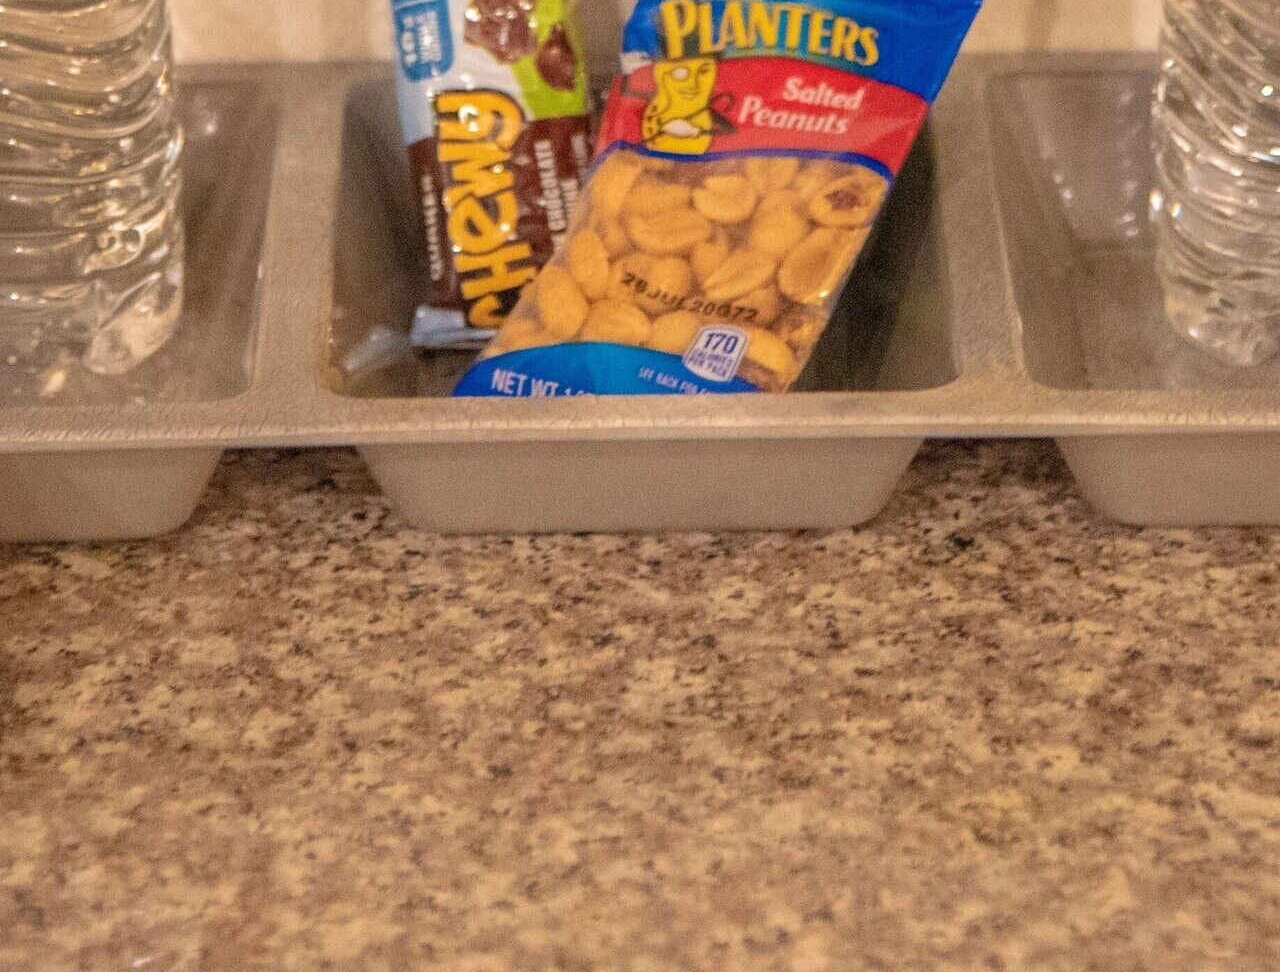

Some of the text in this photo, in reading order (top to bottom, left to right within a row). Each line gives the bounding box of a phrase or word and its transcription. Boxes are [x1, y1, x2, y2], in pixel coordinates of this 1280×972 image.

[781, 75, 867, 111] Salted
[736, 94, 850, 135] Peanuts
[533, 140, 566, 230] CHOCOLATE
[704, 332, 739, 355] 170
[490, 368, 559, 397] NET WT
